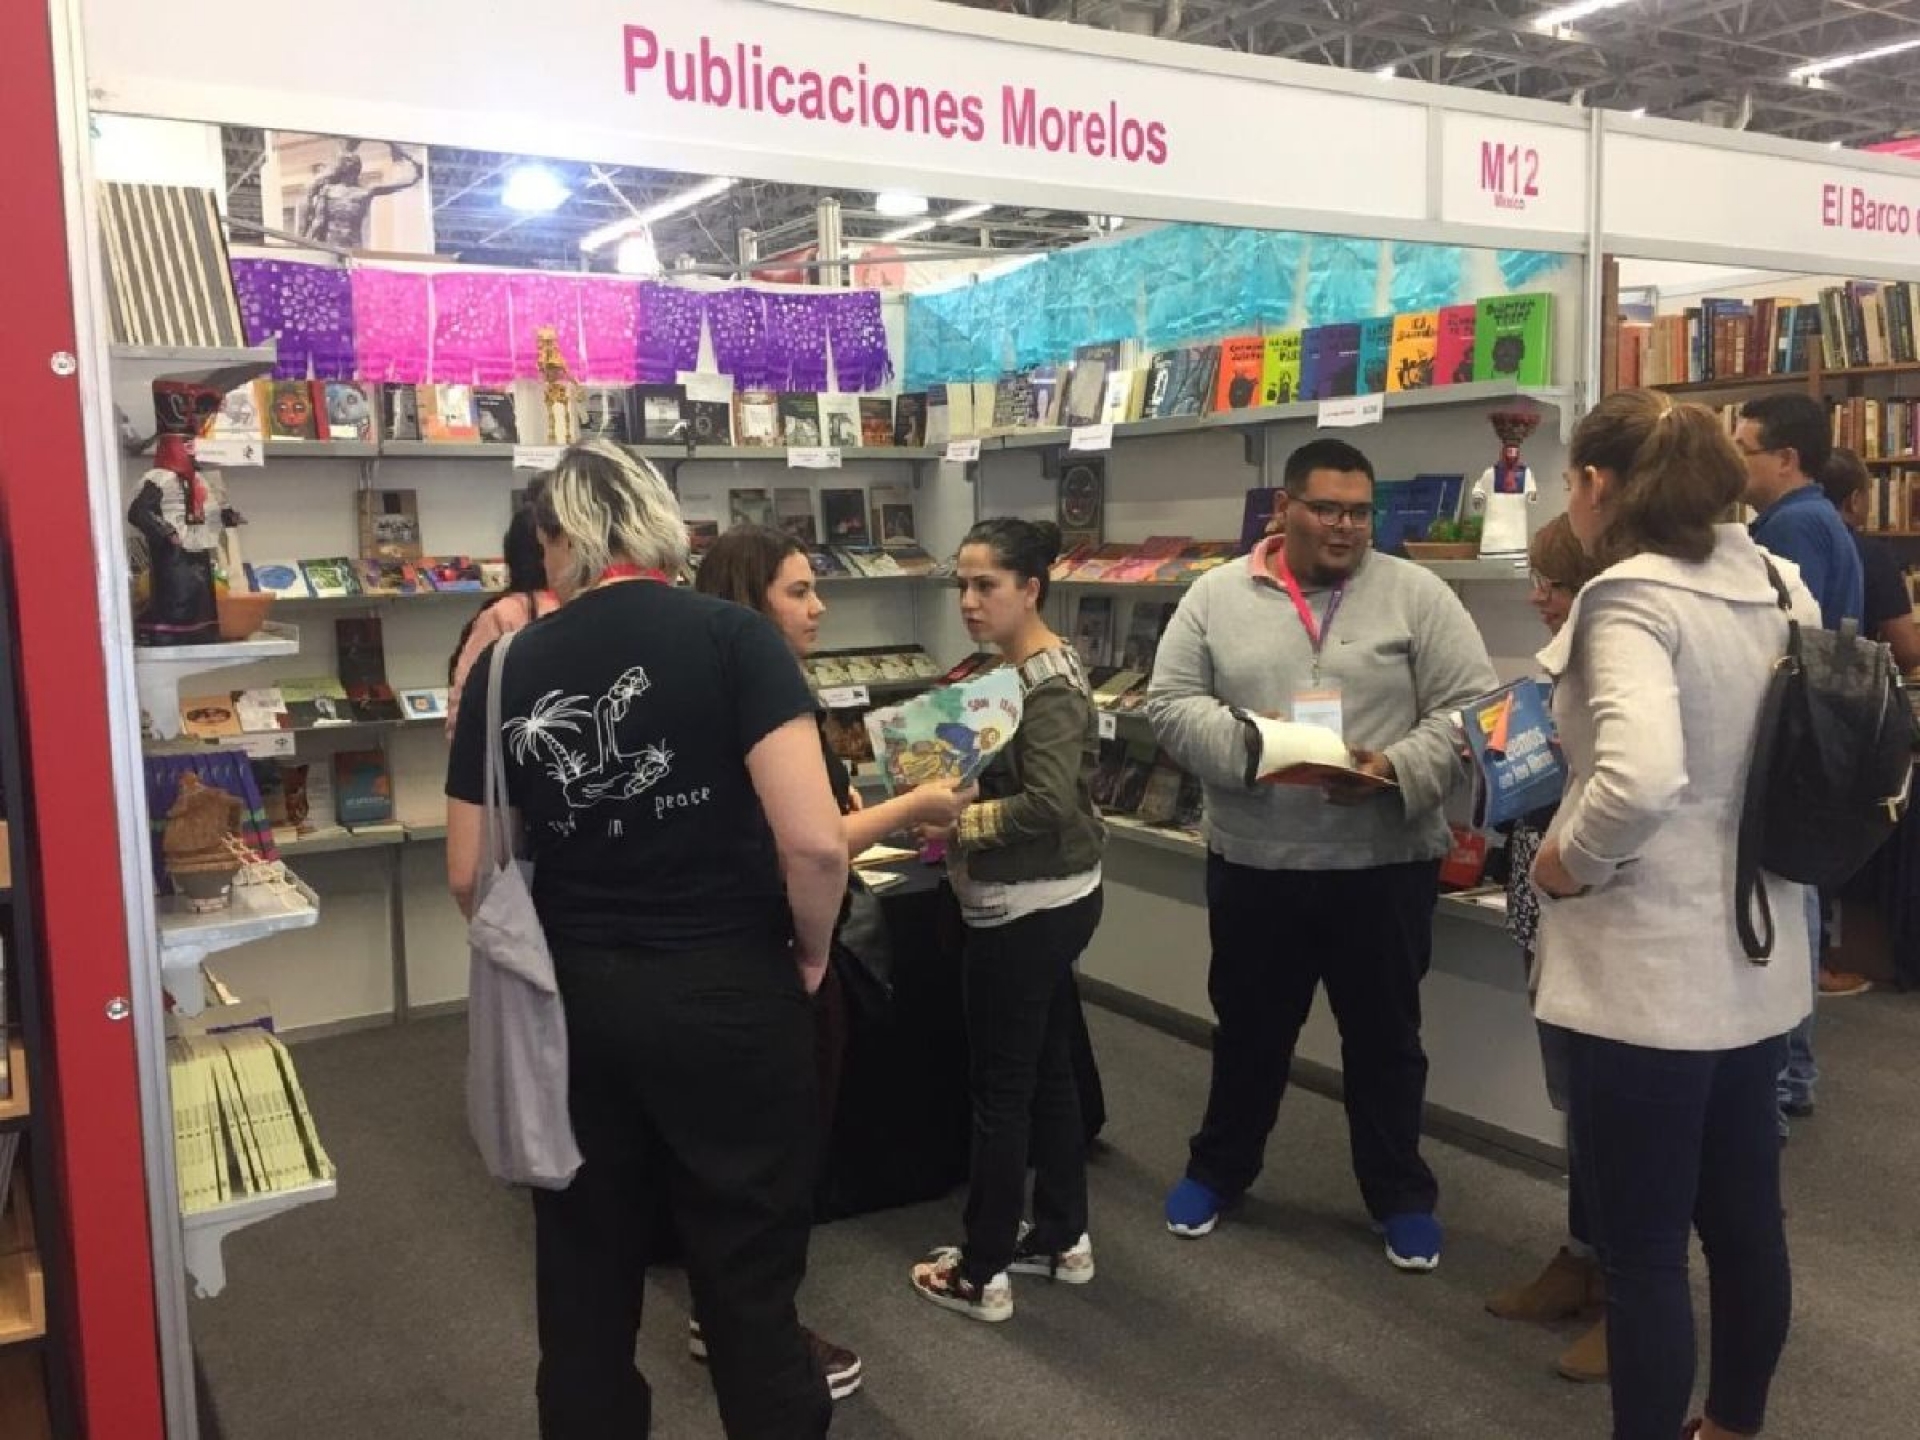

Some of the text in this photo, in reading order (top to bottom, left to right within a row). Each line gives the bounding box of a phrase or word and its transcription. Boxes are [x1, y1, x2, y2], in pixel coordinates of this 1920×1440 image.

[623, 24, 1168, 165] Publicaciones Morelos
[1482, 141, 1538, 196] M12
[1823, 184, 1843, 226] El
[1851, 187, 1910, 232] Barco
